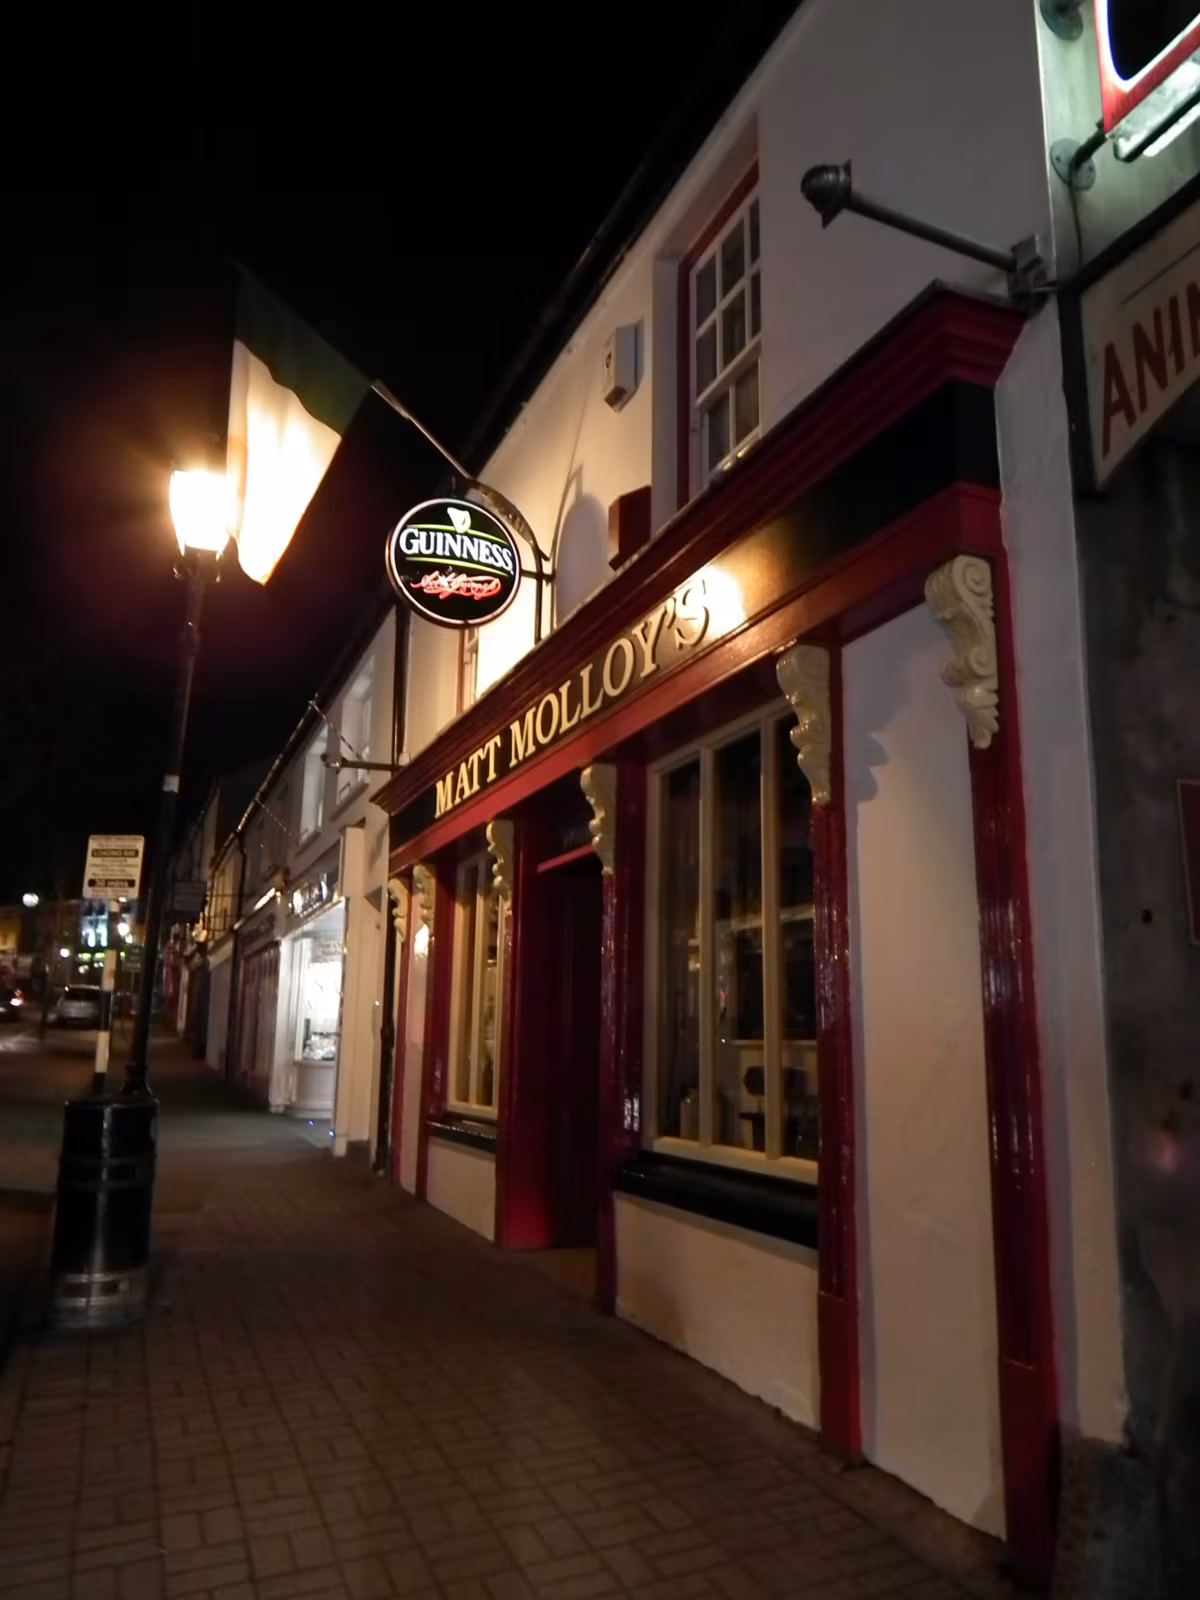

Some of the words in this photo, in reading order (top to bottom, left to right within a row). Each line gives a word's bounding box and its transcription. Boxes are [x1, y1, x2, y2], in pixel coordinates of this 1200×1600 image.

[399, 528, 513, 571] GUINNESS
[434, 734, 501, 818] MATT
[509, 579, 710, 768] MOLLOY'S
